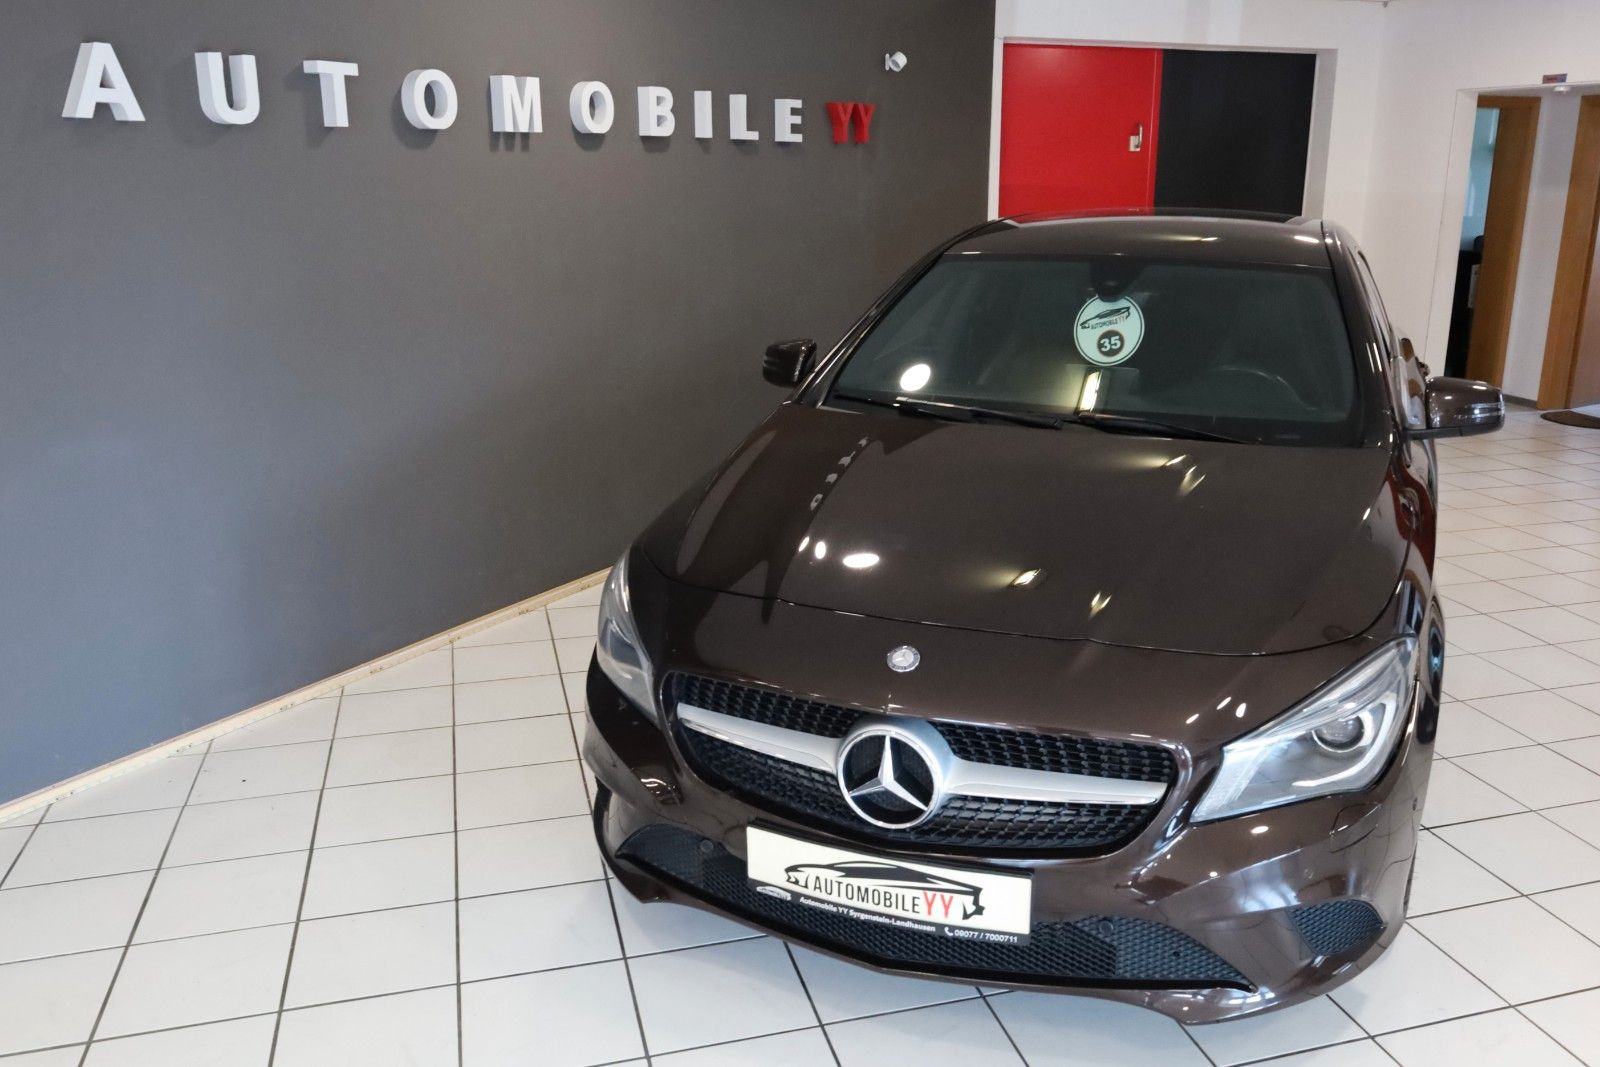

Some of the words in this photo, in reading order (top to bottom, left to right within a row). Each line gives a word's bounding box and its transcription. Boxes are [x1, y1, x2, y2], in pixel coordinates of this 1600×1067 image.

[62, 41, 803, 143] AUTOMOBILE
[825, 101, 877, 145] YY
[1100, 335, 1121, 352] 35
[799, 896, 838, 912] Automobile
